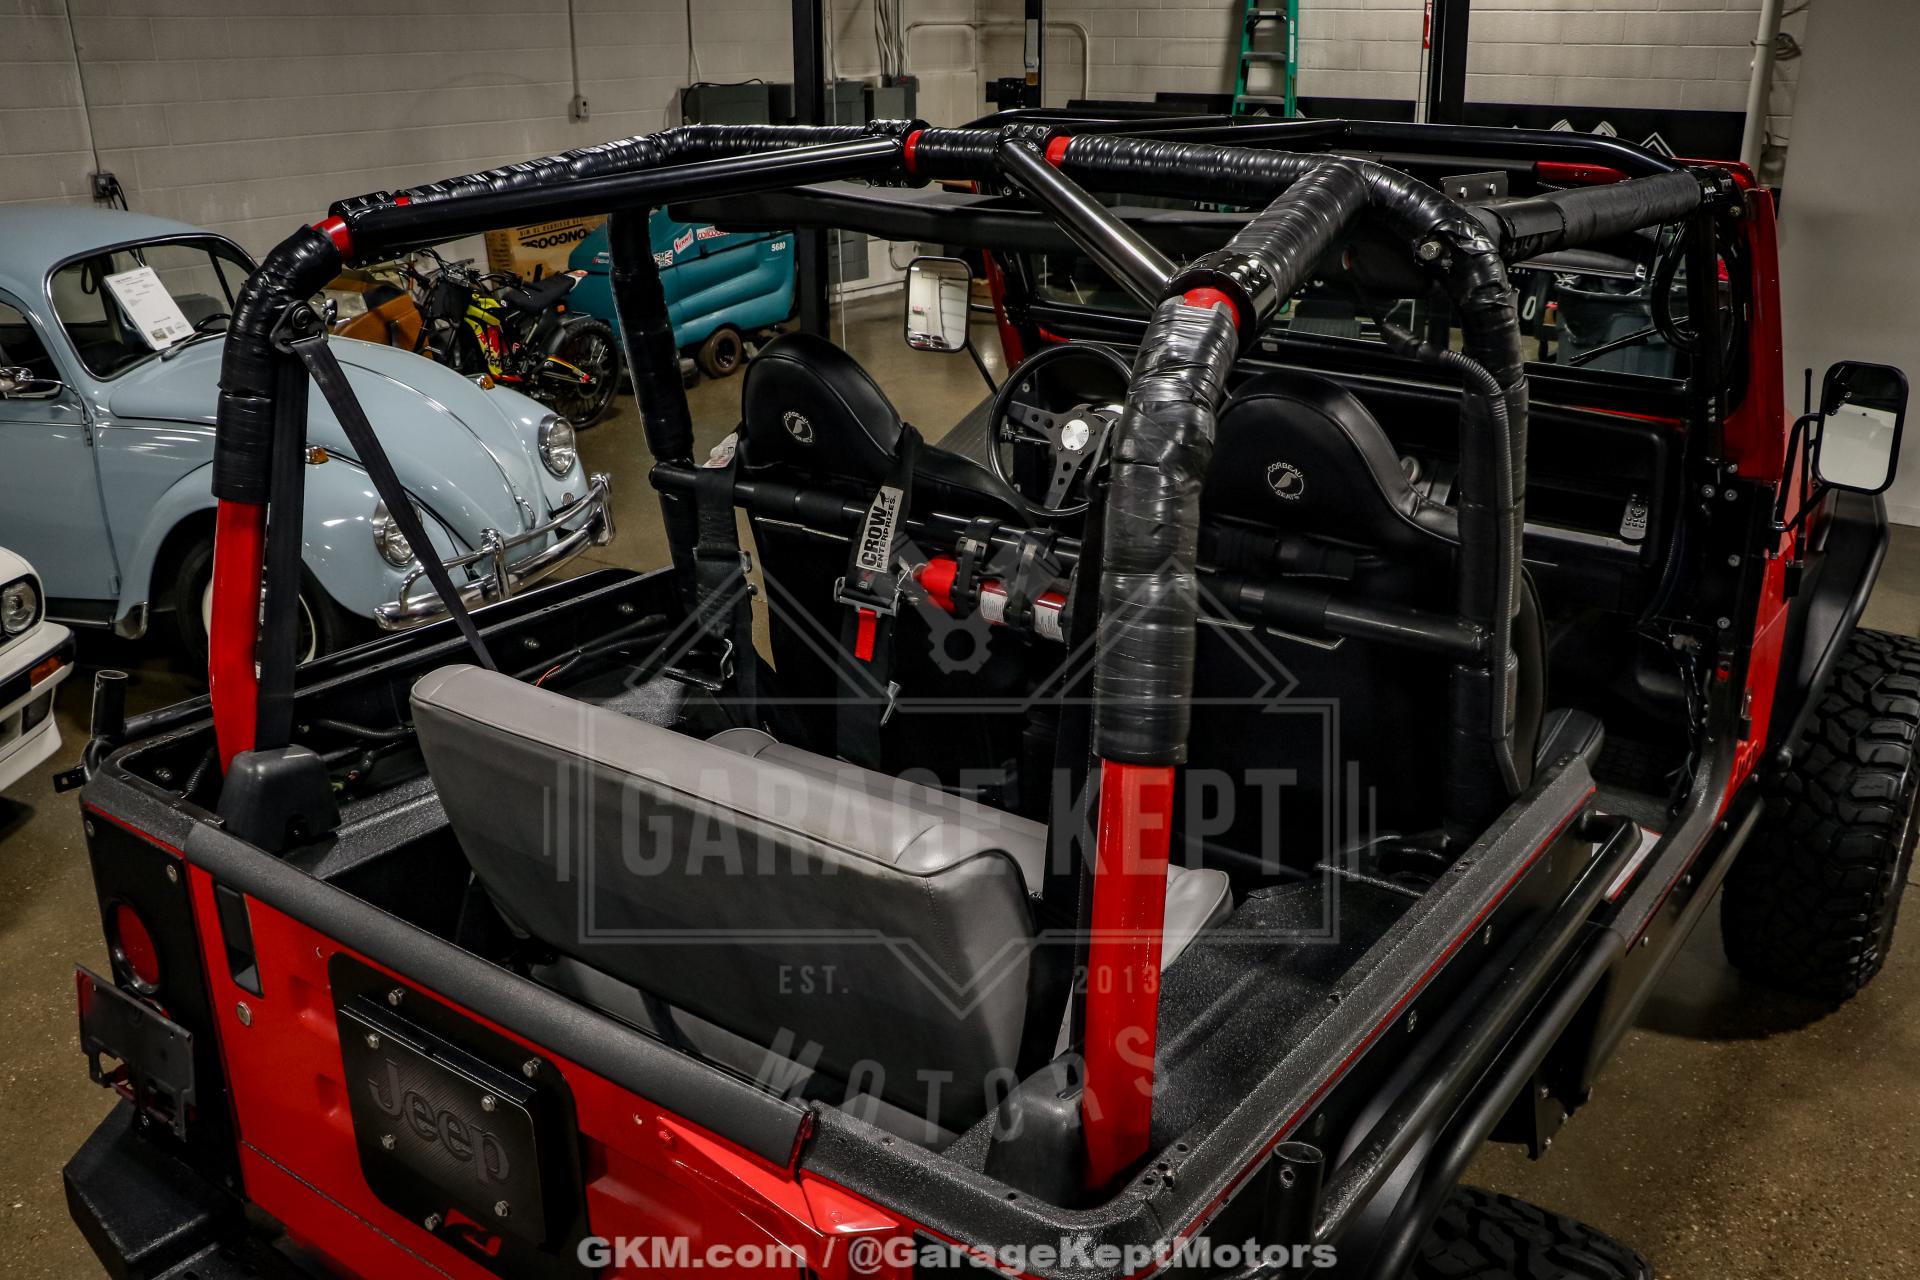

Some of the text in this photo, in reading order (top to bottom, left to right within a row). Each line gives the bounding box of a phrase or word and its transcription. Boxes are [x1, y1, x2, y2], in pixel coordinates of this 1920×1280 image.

[1267, 461, 1304, 478] CORBEAU
[861, 505, 888, 567] CROW
[368, 1058, 511, 1184] Jeep
